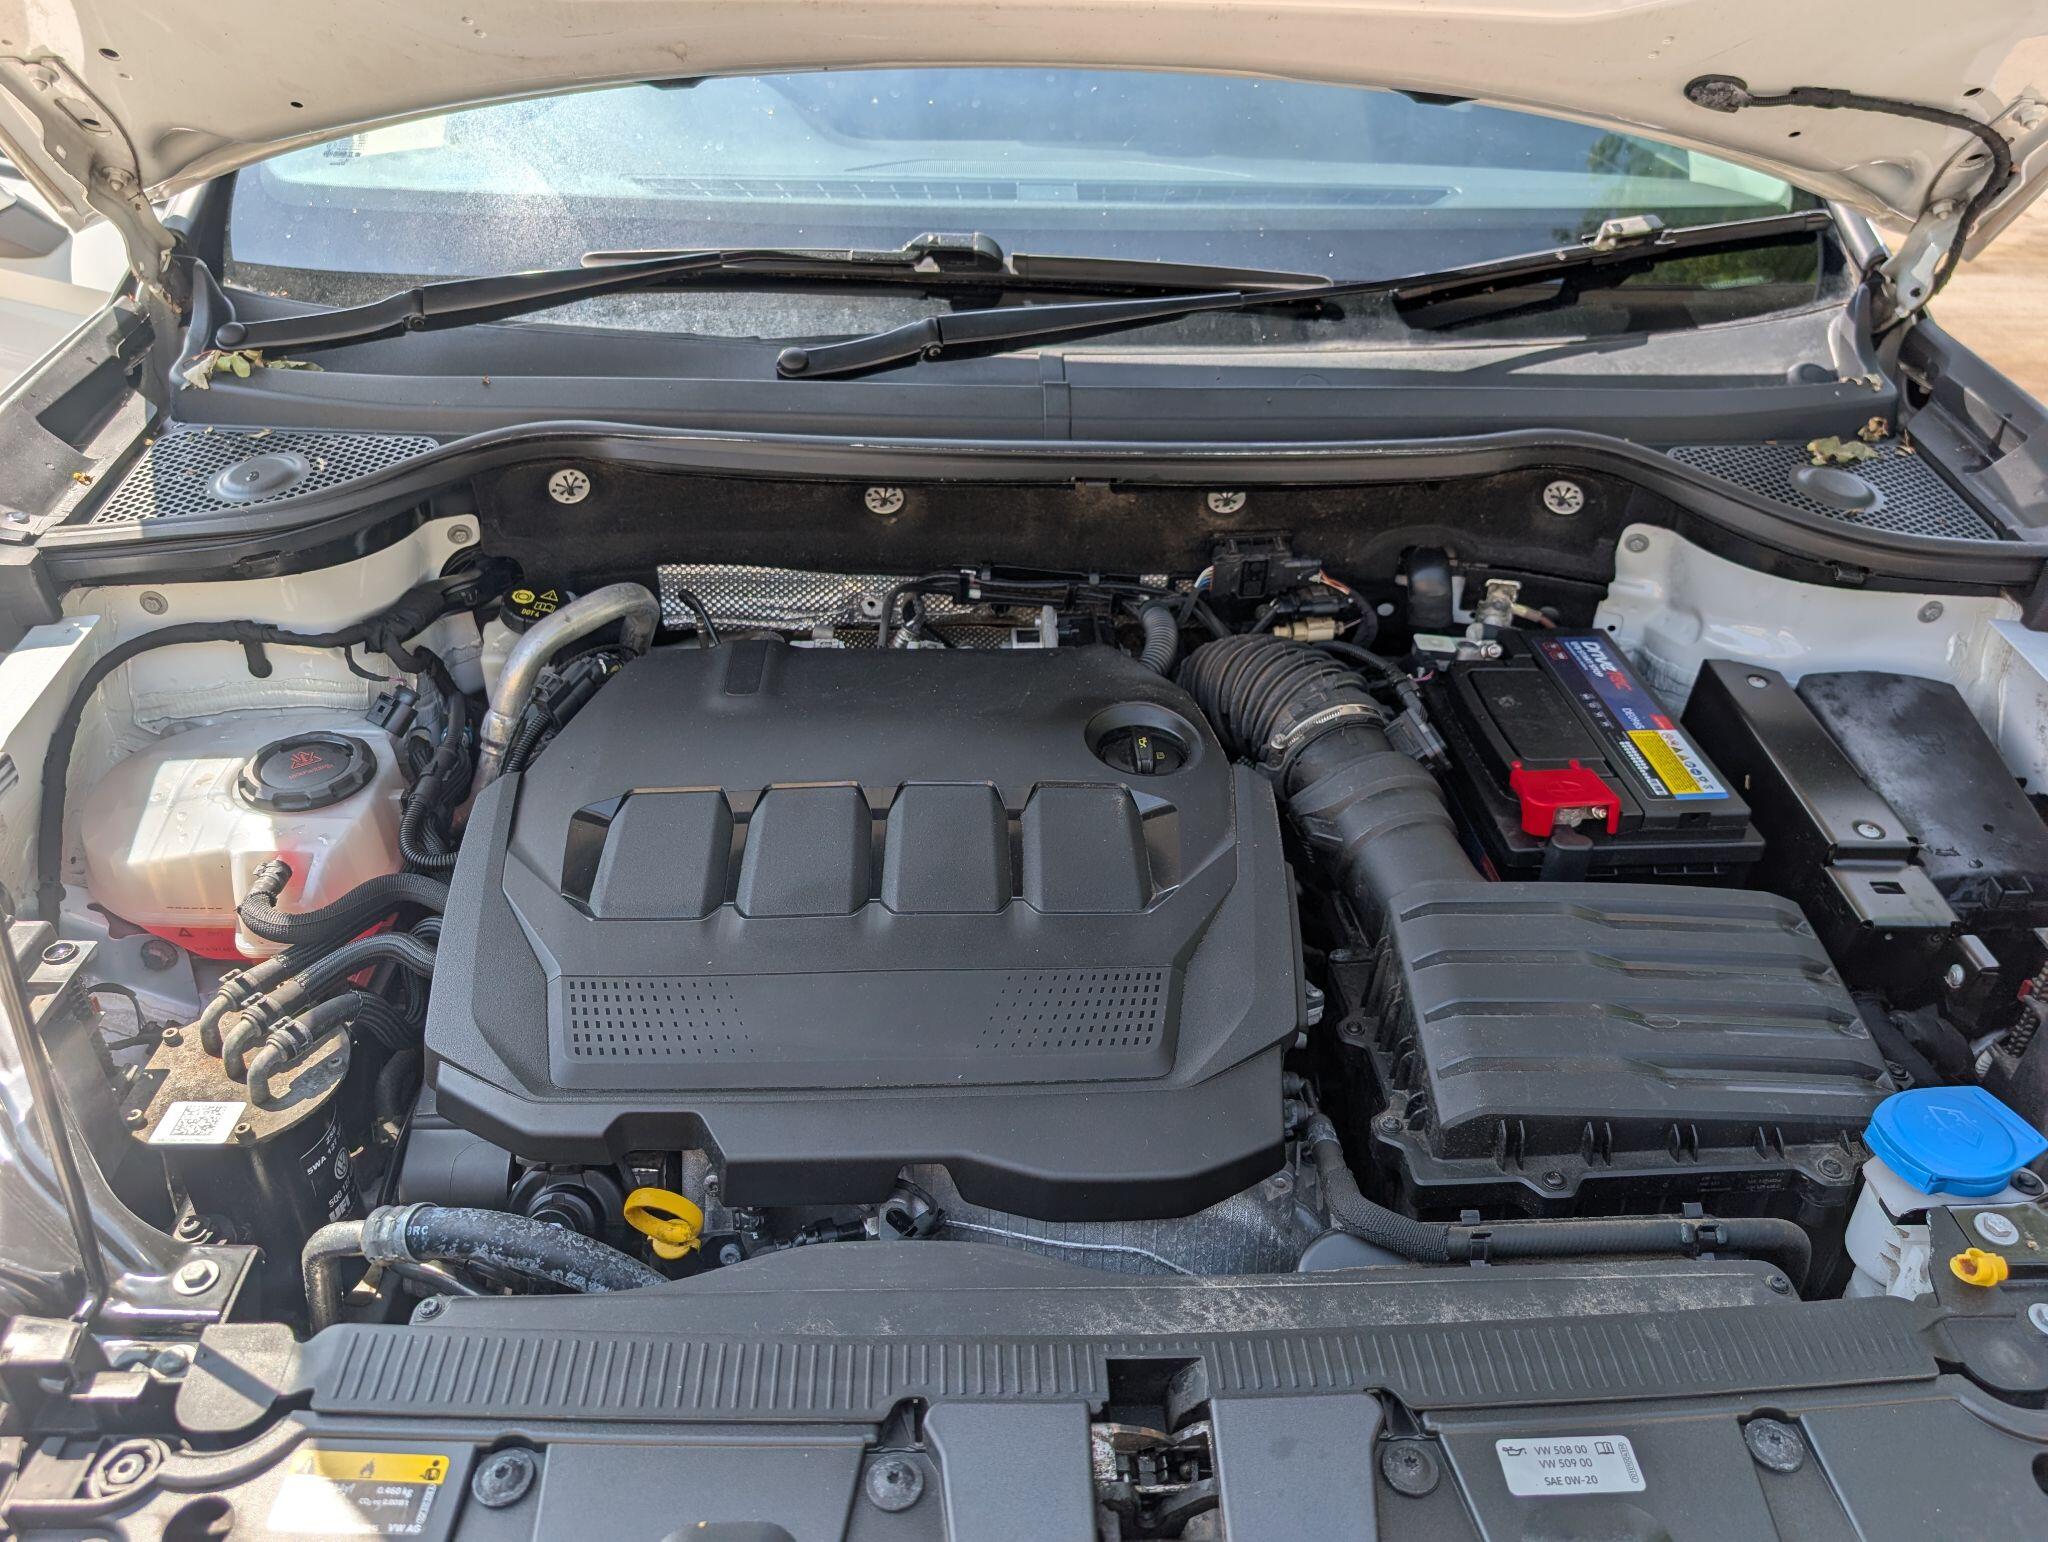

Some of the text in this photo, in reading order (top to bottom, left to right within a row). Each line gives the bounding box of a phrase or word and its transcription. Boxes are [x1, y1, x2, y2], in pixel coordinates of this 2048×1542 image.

[1534, 1444, 1588, 1455] VW 508 00
[1538, 1457, 1593, 1469] VW 509 00
[1544, 1475, 1599, 1486] SAE 0W-20
[388, 1523, 406, 1532] VW
